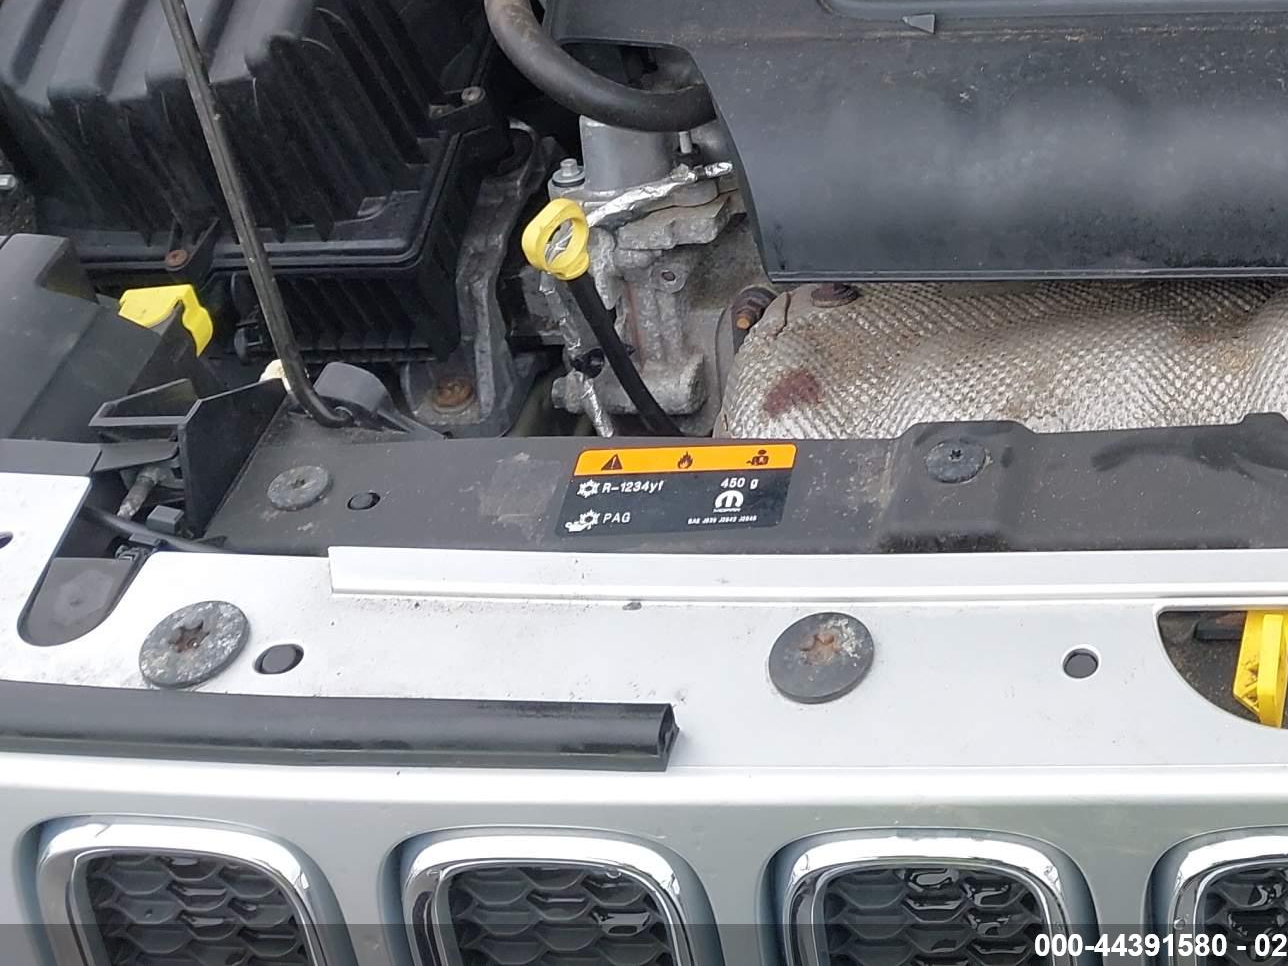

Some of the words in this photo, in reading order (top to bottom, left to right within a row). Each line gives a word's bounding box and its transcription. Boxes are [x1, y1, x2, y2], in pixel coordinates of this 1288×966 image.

[602, 480, 664, 494] R-1234yf
[720, 477, 746, 489] 450
[750, 478, 759, 490] g
[602, 512, 631, 524] PAG
